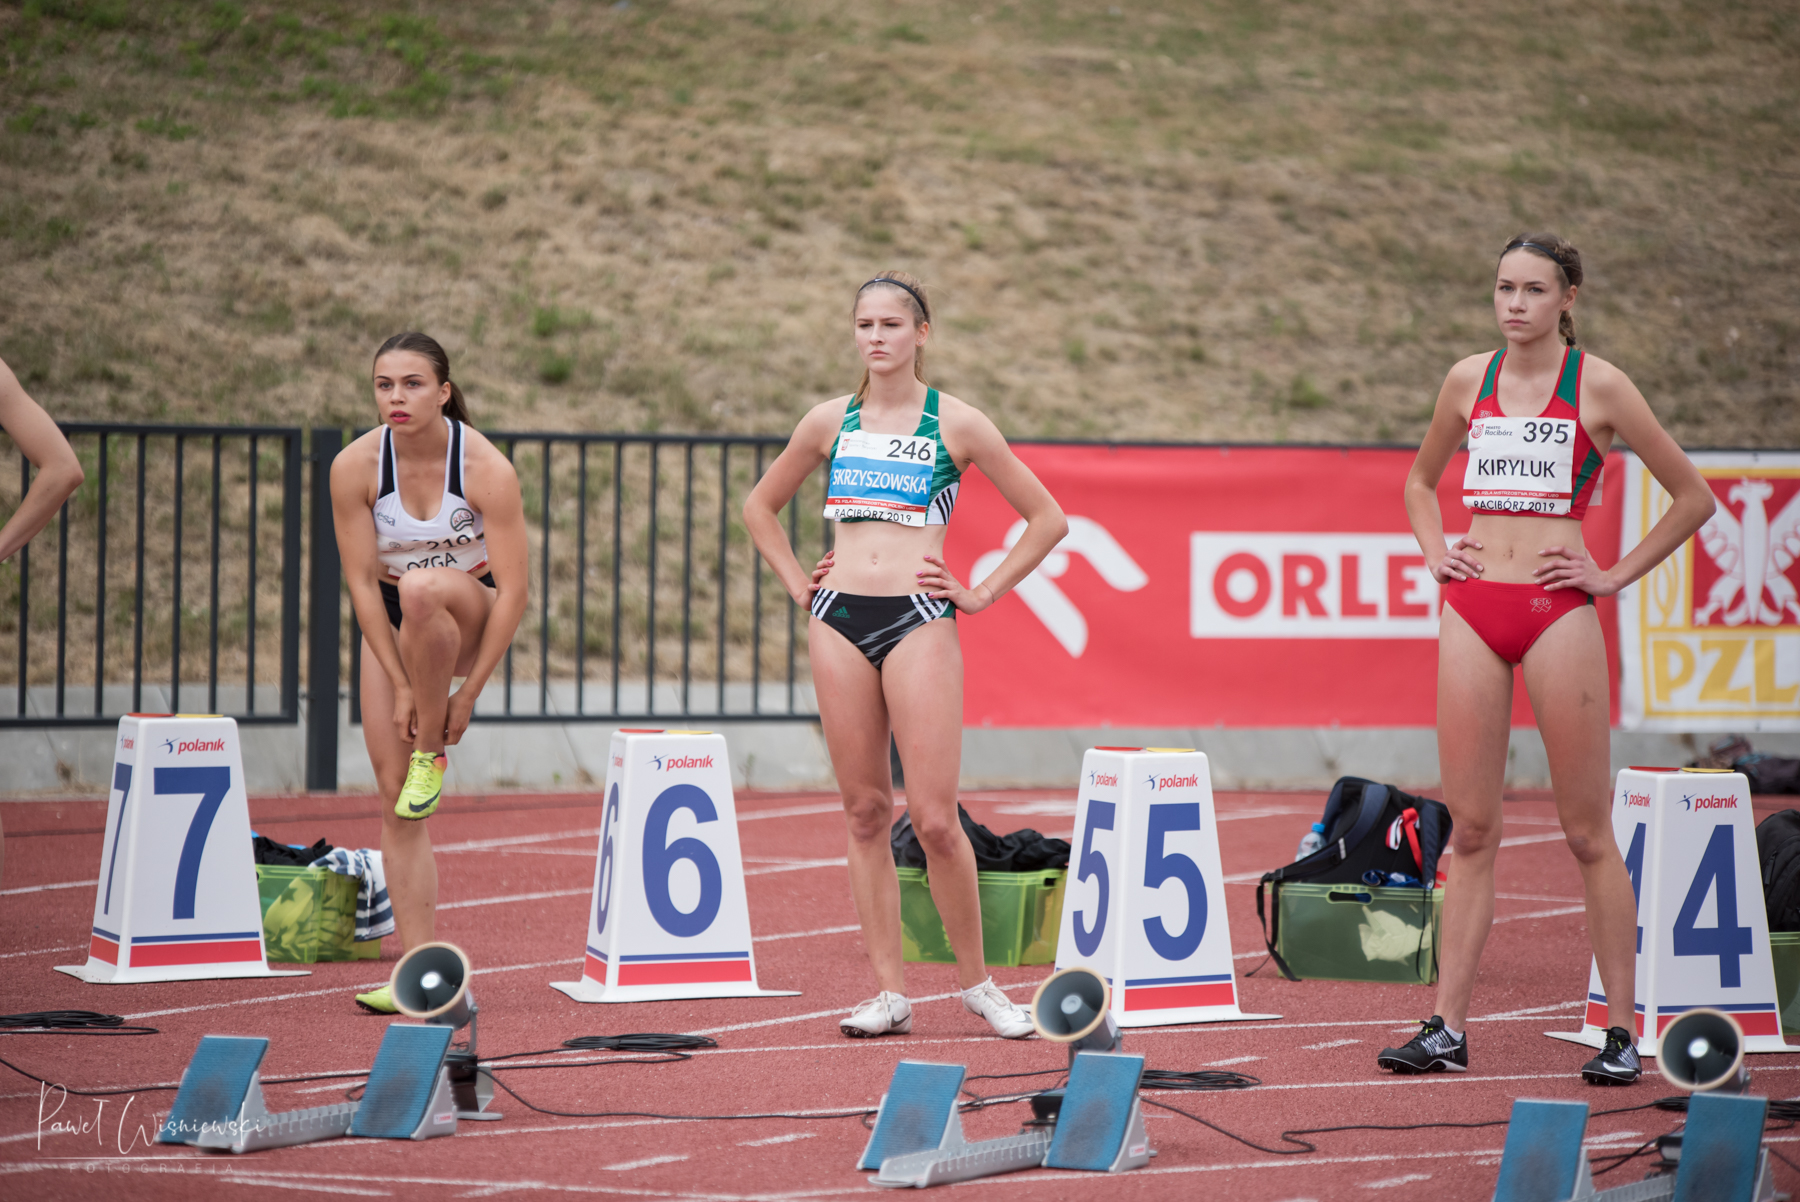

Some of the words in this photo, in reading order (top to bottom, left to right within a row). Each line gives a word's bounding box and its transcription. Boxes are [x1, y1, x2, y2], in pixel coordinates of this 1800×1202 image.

[1485, 429, 1513, 437] Racibórz
[1523, 421, 1569, 445] 395
[887, 439, 932, 461] 246
[1478, 459, 1556, 479] KIRYLUK
[832, 469, 928, 495] SKRZYSZOWSKA
[834, 507, 884, 520] RACIBÓRZ
[887, 512, 912, 523] 2019
[1473, 498, 1525, 511] RACIBÓRZ
[1528, 501, 1556, 512] 2019
[453, 511, 471, 525] RKS
[426, 534, 472, 551] 210
[1212, 552, 1443, 619] ORLE
[1652, 639, 1800, 703] PZL
[177, 738, 226, 755] polanik
[666, 755, 714, 772] polanik
[1095, 772, 1119, 788] polanik
[1159, 774, 1199, 791] polanik
[1628, 792, 1651, 808] polanik
[1695, 794, 1738, 812] polanik
[103, 762, 133, 915] 7
[154, 766, 231, 920] 7
[597, 782, 619, 935] 6
[642, 783, 722, 938] 6
[1073, 799, 1116, 957] 5
[1143, 803, 1208, 961] 5
[1672, 824, 1753, 988] 4
